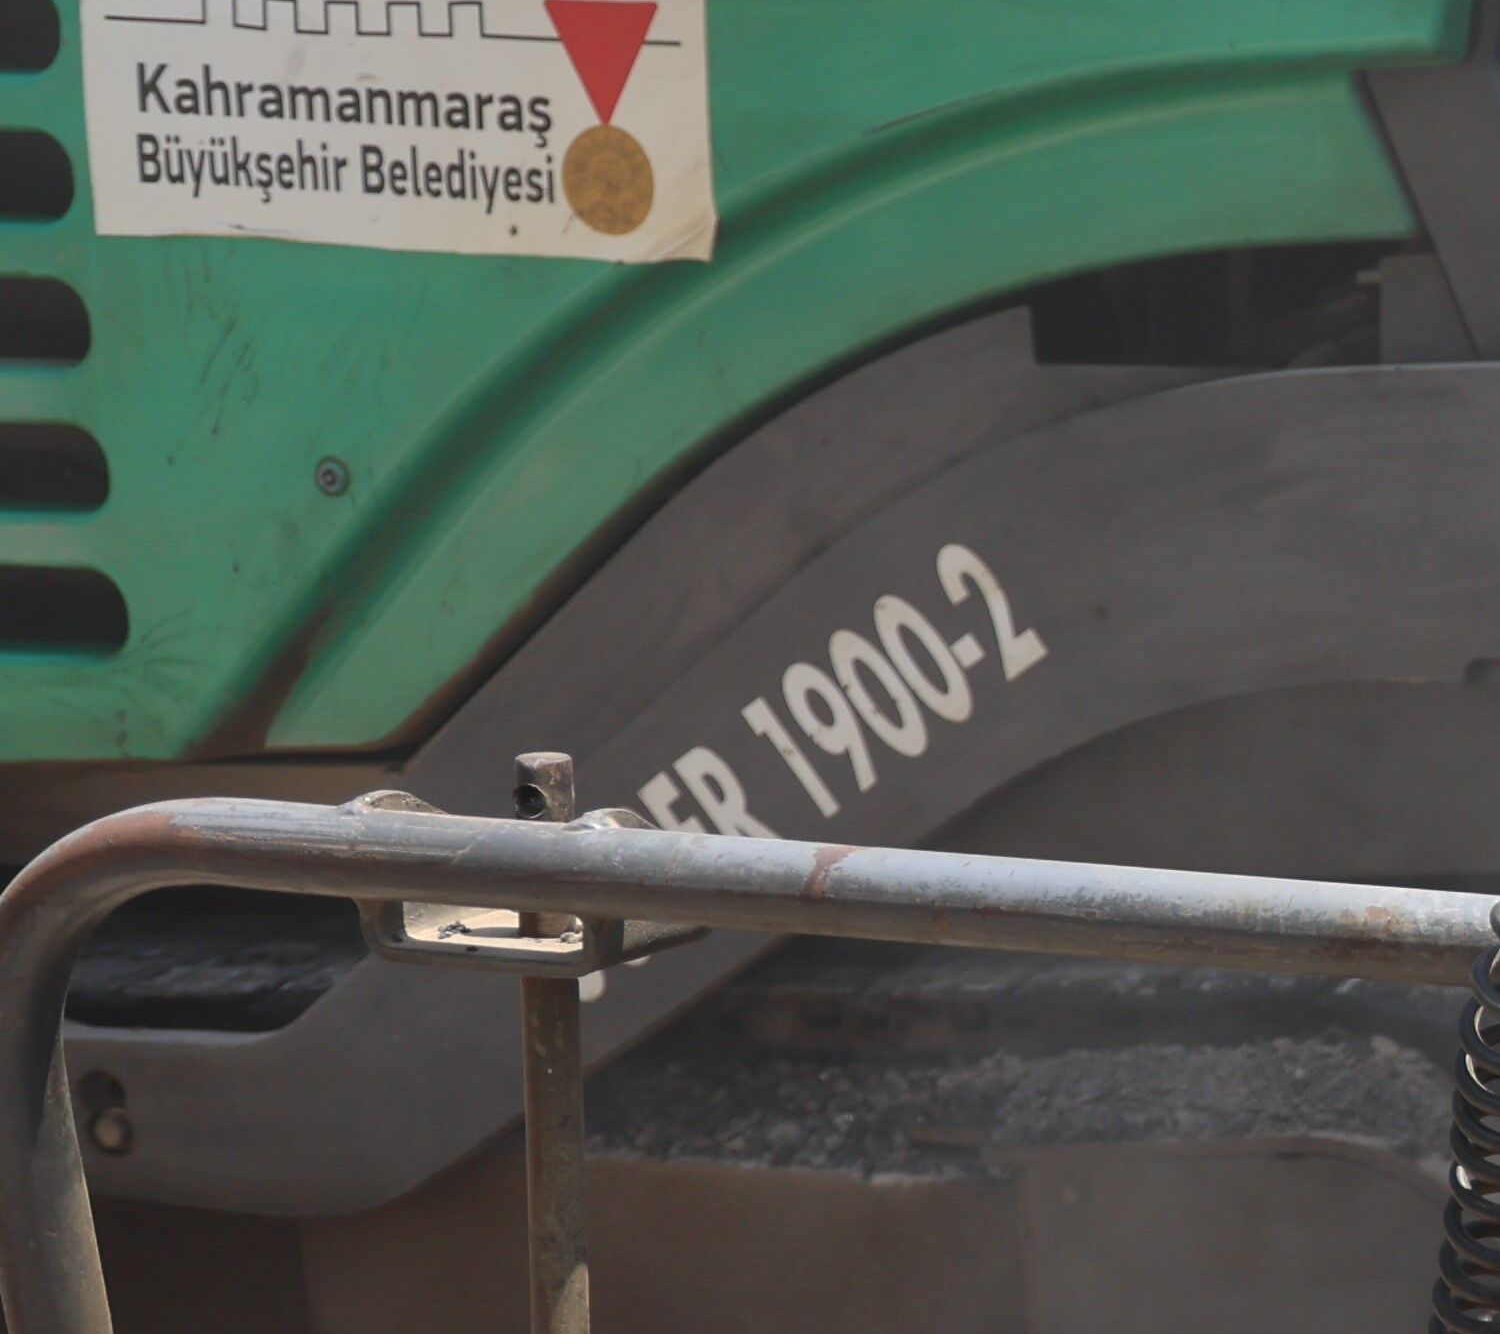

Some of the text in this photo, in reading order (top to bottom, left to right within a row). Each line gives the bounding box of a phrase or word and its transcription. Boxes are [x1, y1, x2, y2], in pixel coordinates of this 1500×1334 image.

[136, 63, 552, 148] Kahramanmaraş
[136, 133, 556, 214] Büyükşehir Belediyesi
[741, 543, 1049, 819] 1900-2
